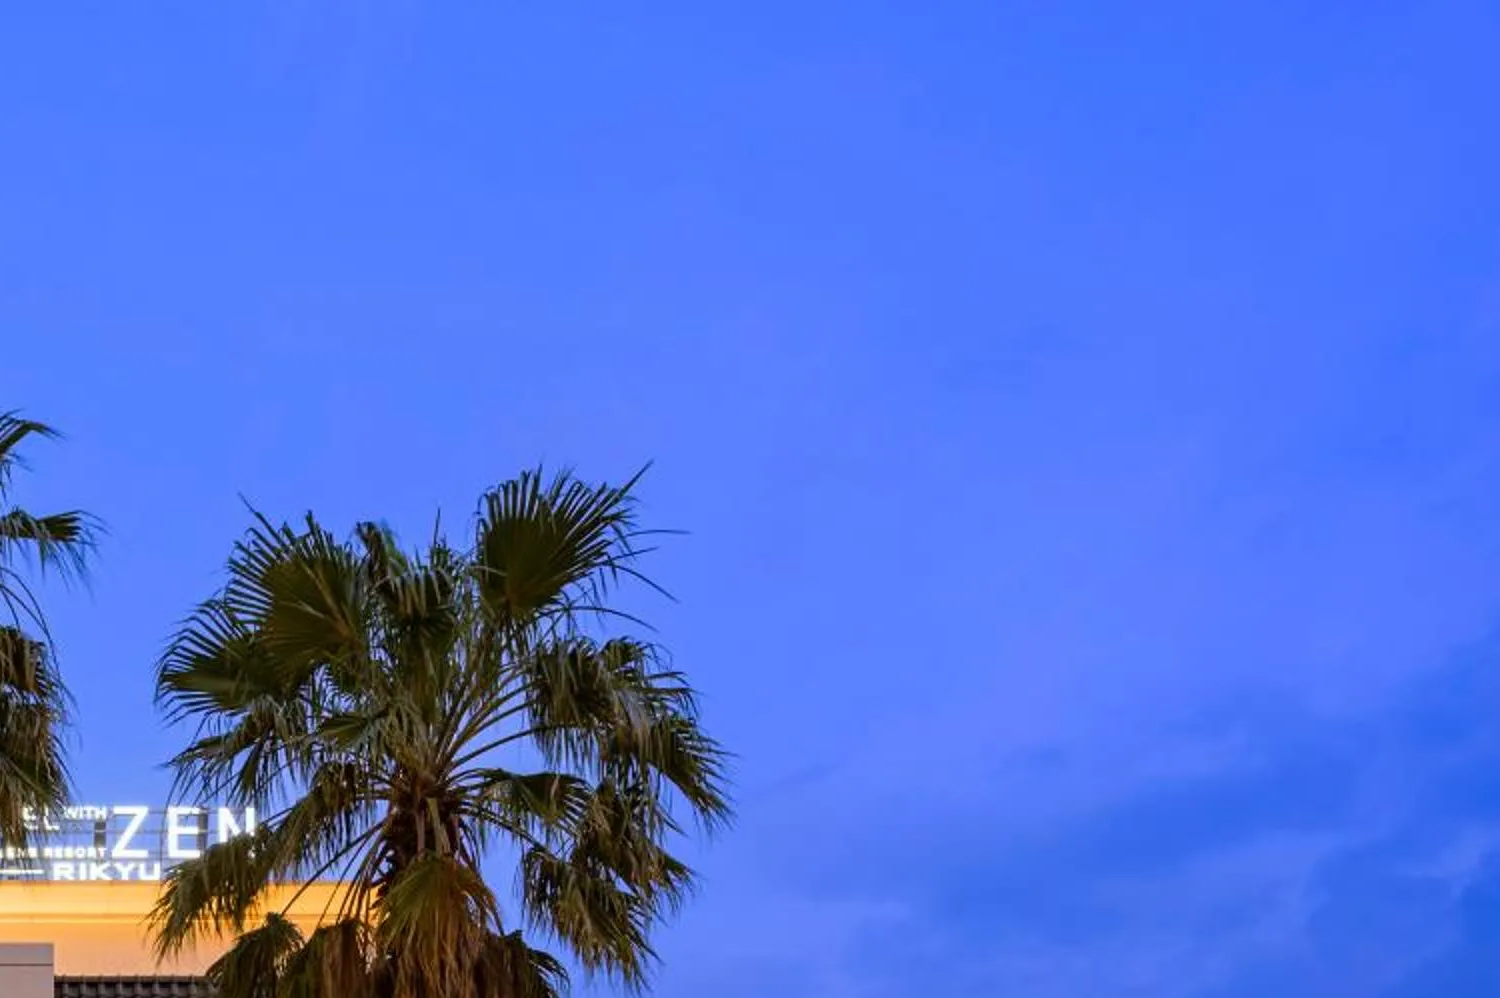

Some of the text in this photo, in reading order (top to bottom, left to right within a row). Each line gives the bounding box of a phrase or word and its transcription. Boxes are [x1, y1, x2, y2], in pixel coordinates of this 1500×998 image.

[62, 806, 108, 820] WITH
[111, 805, 256, 859] ZEN
[52, 862, 161, 881] RIKYU
